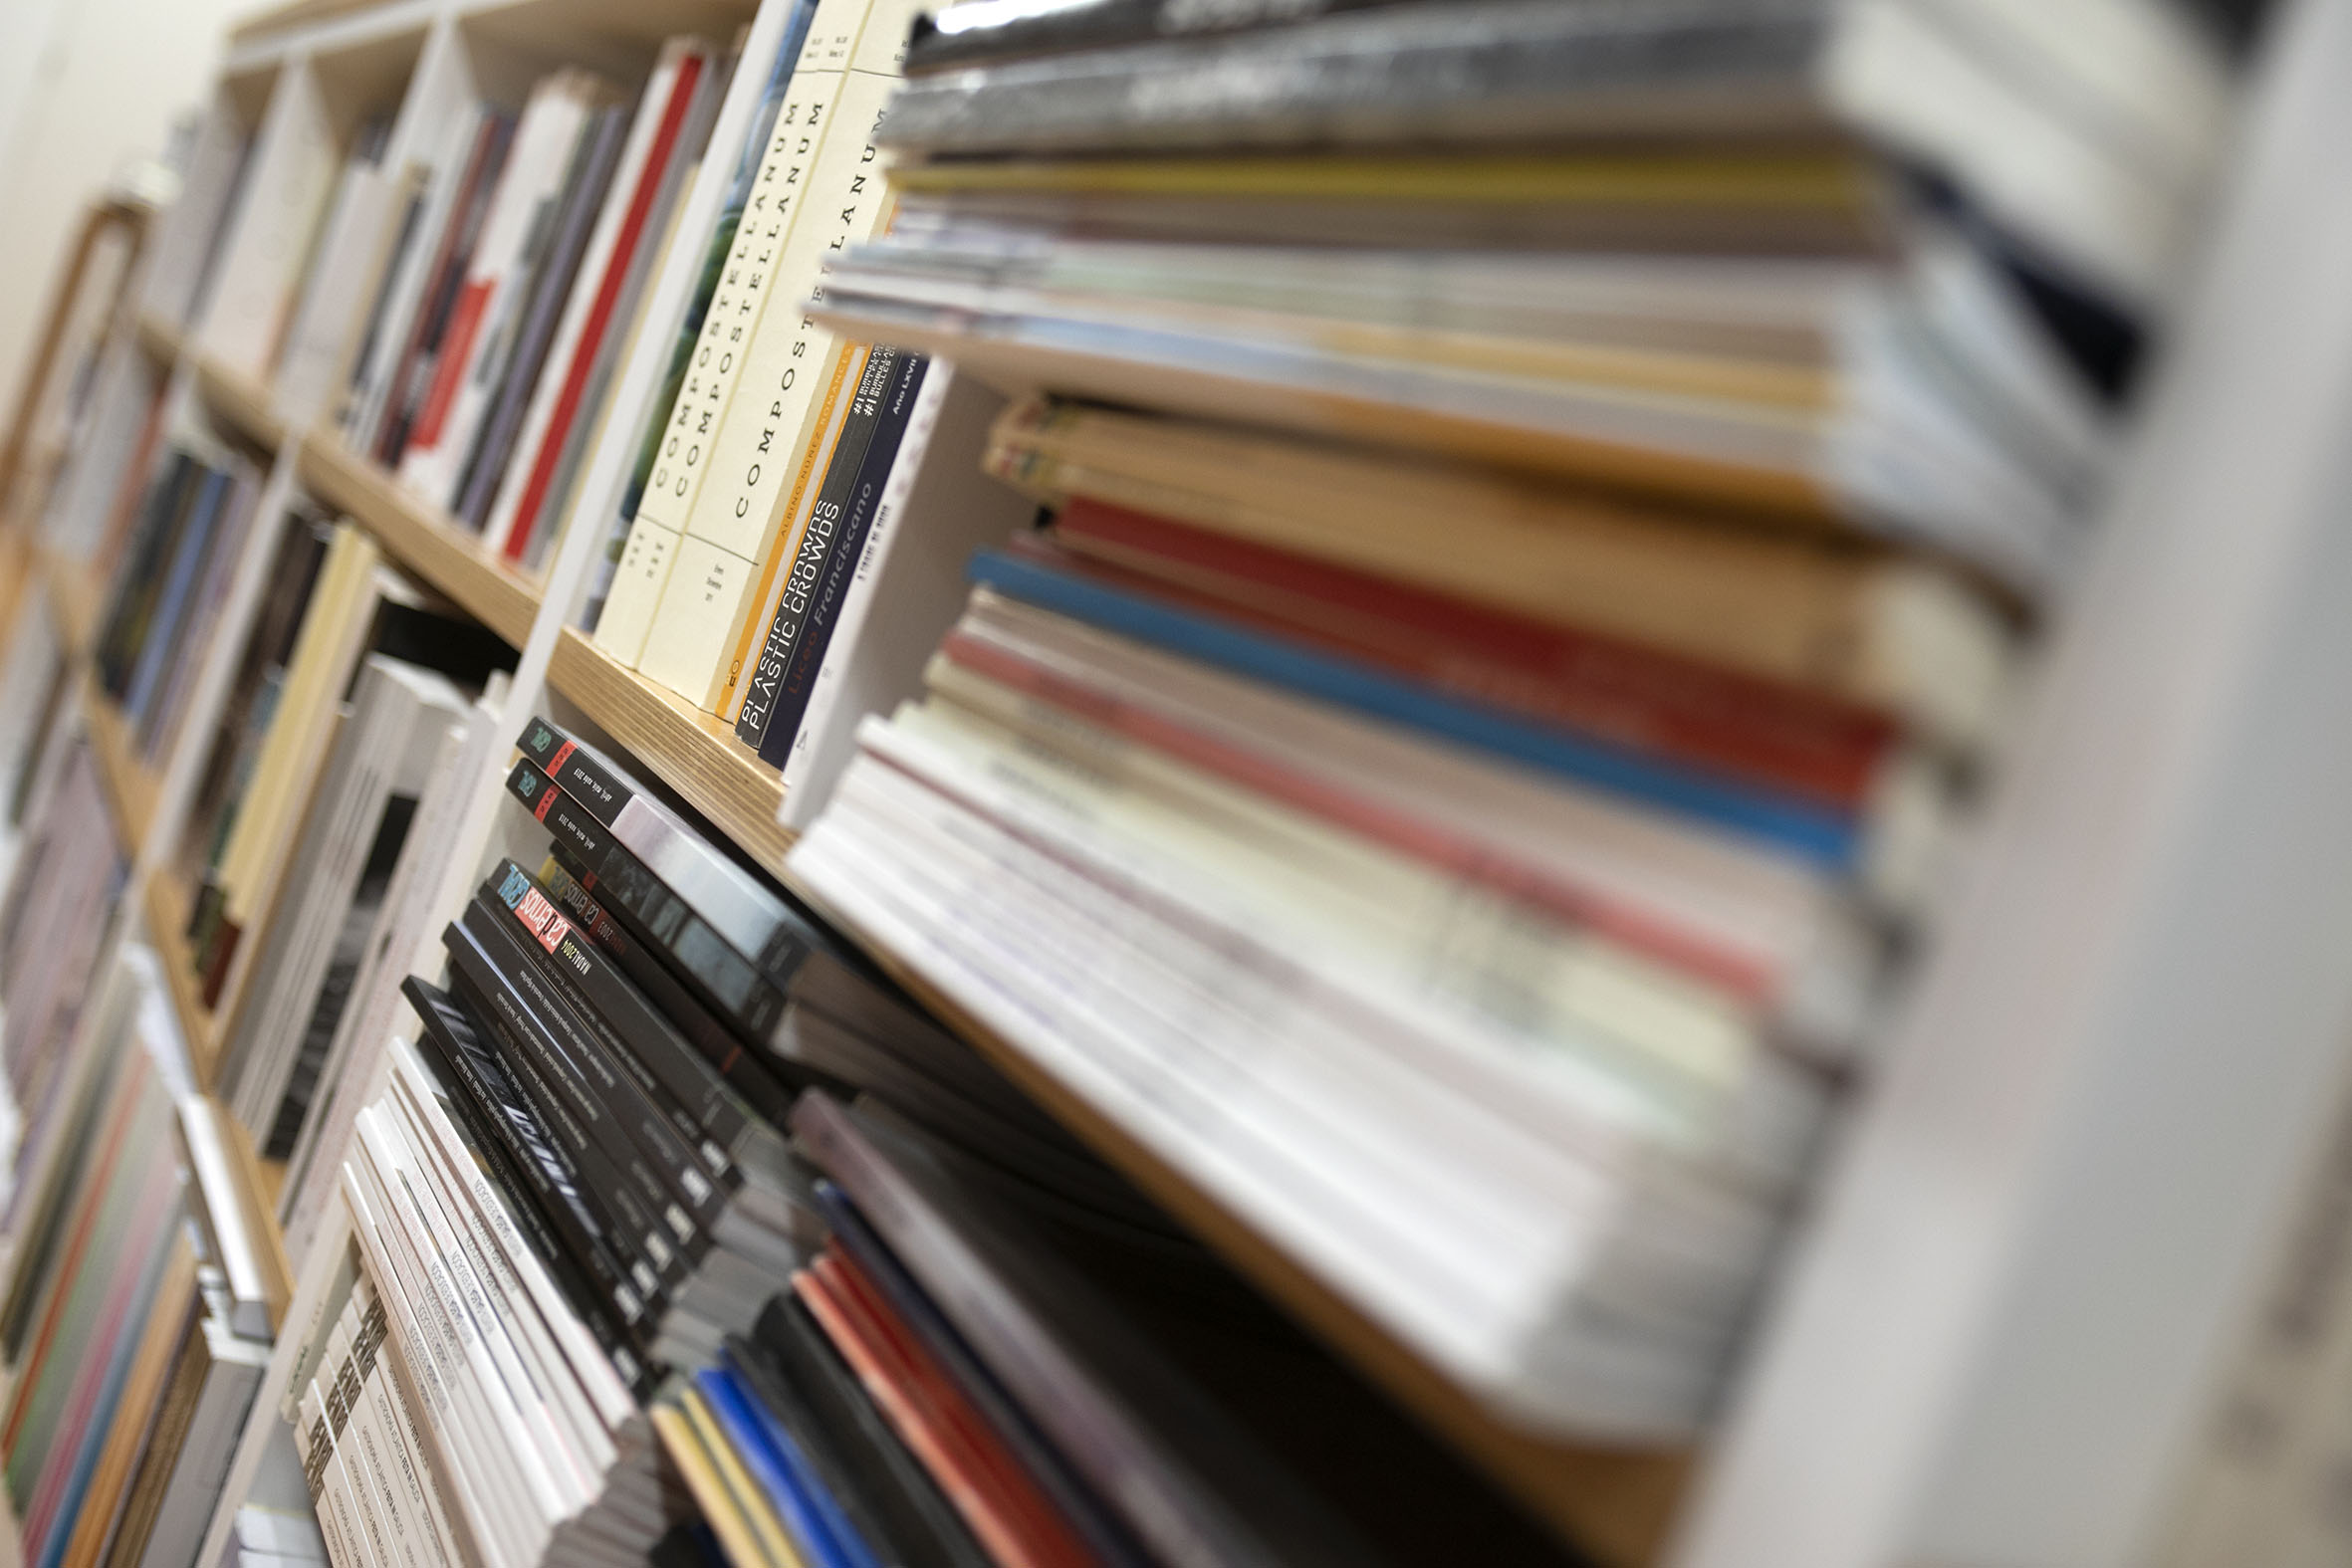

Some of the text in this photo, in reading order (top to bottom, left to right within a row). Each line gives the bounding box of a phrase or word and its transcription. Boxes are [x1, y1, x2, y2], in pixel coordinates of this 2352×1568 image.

[655, 103, 800, 489] COMPOSTELLANUM
[675, 102, 824, 498] COMPOSTELLANUM
[892, 358, 915, 413] Año LXVII
[781, 485, 801, 537] ALBINO
[749, 502, 838, 729] PLASTIC CROWDS
[787, 482, 872, 696] Liceo Franciscano
[599, 788, 611, 802] abril,
[519, 888, 567, 947] cadernos
[400, 1457, 409, 1473] FEITA
